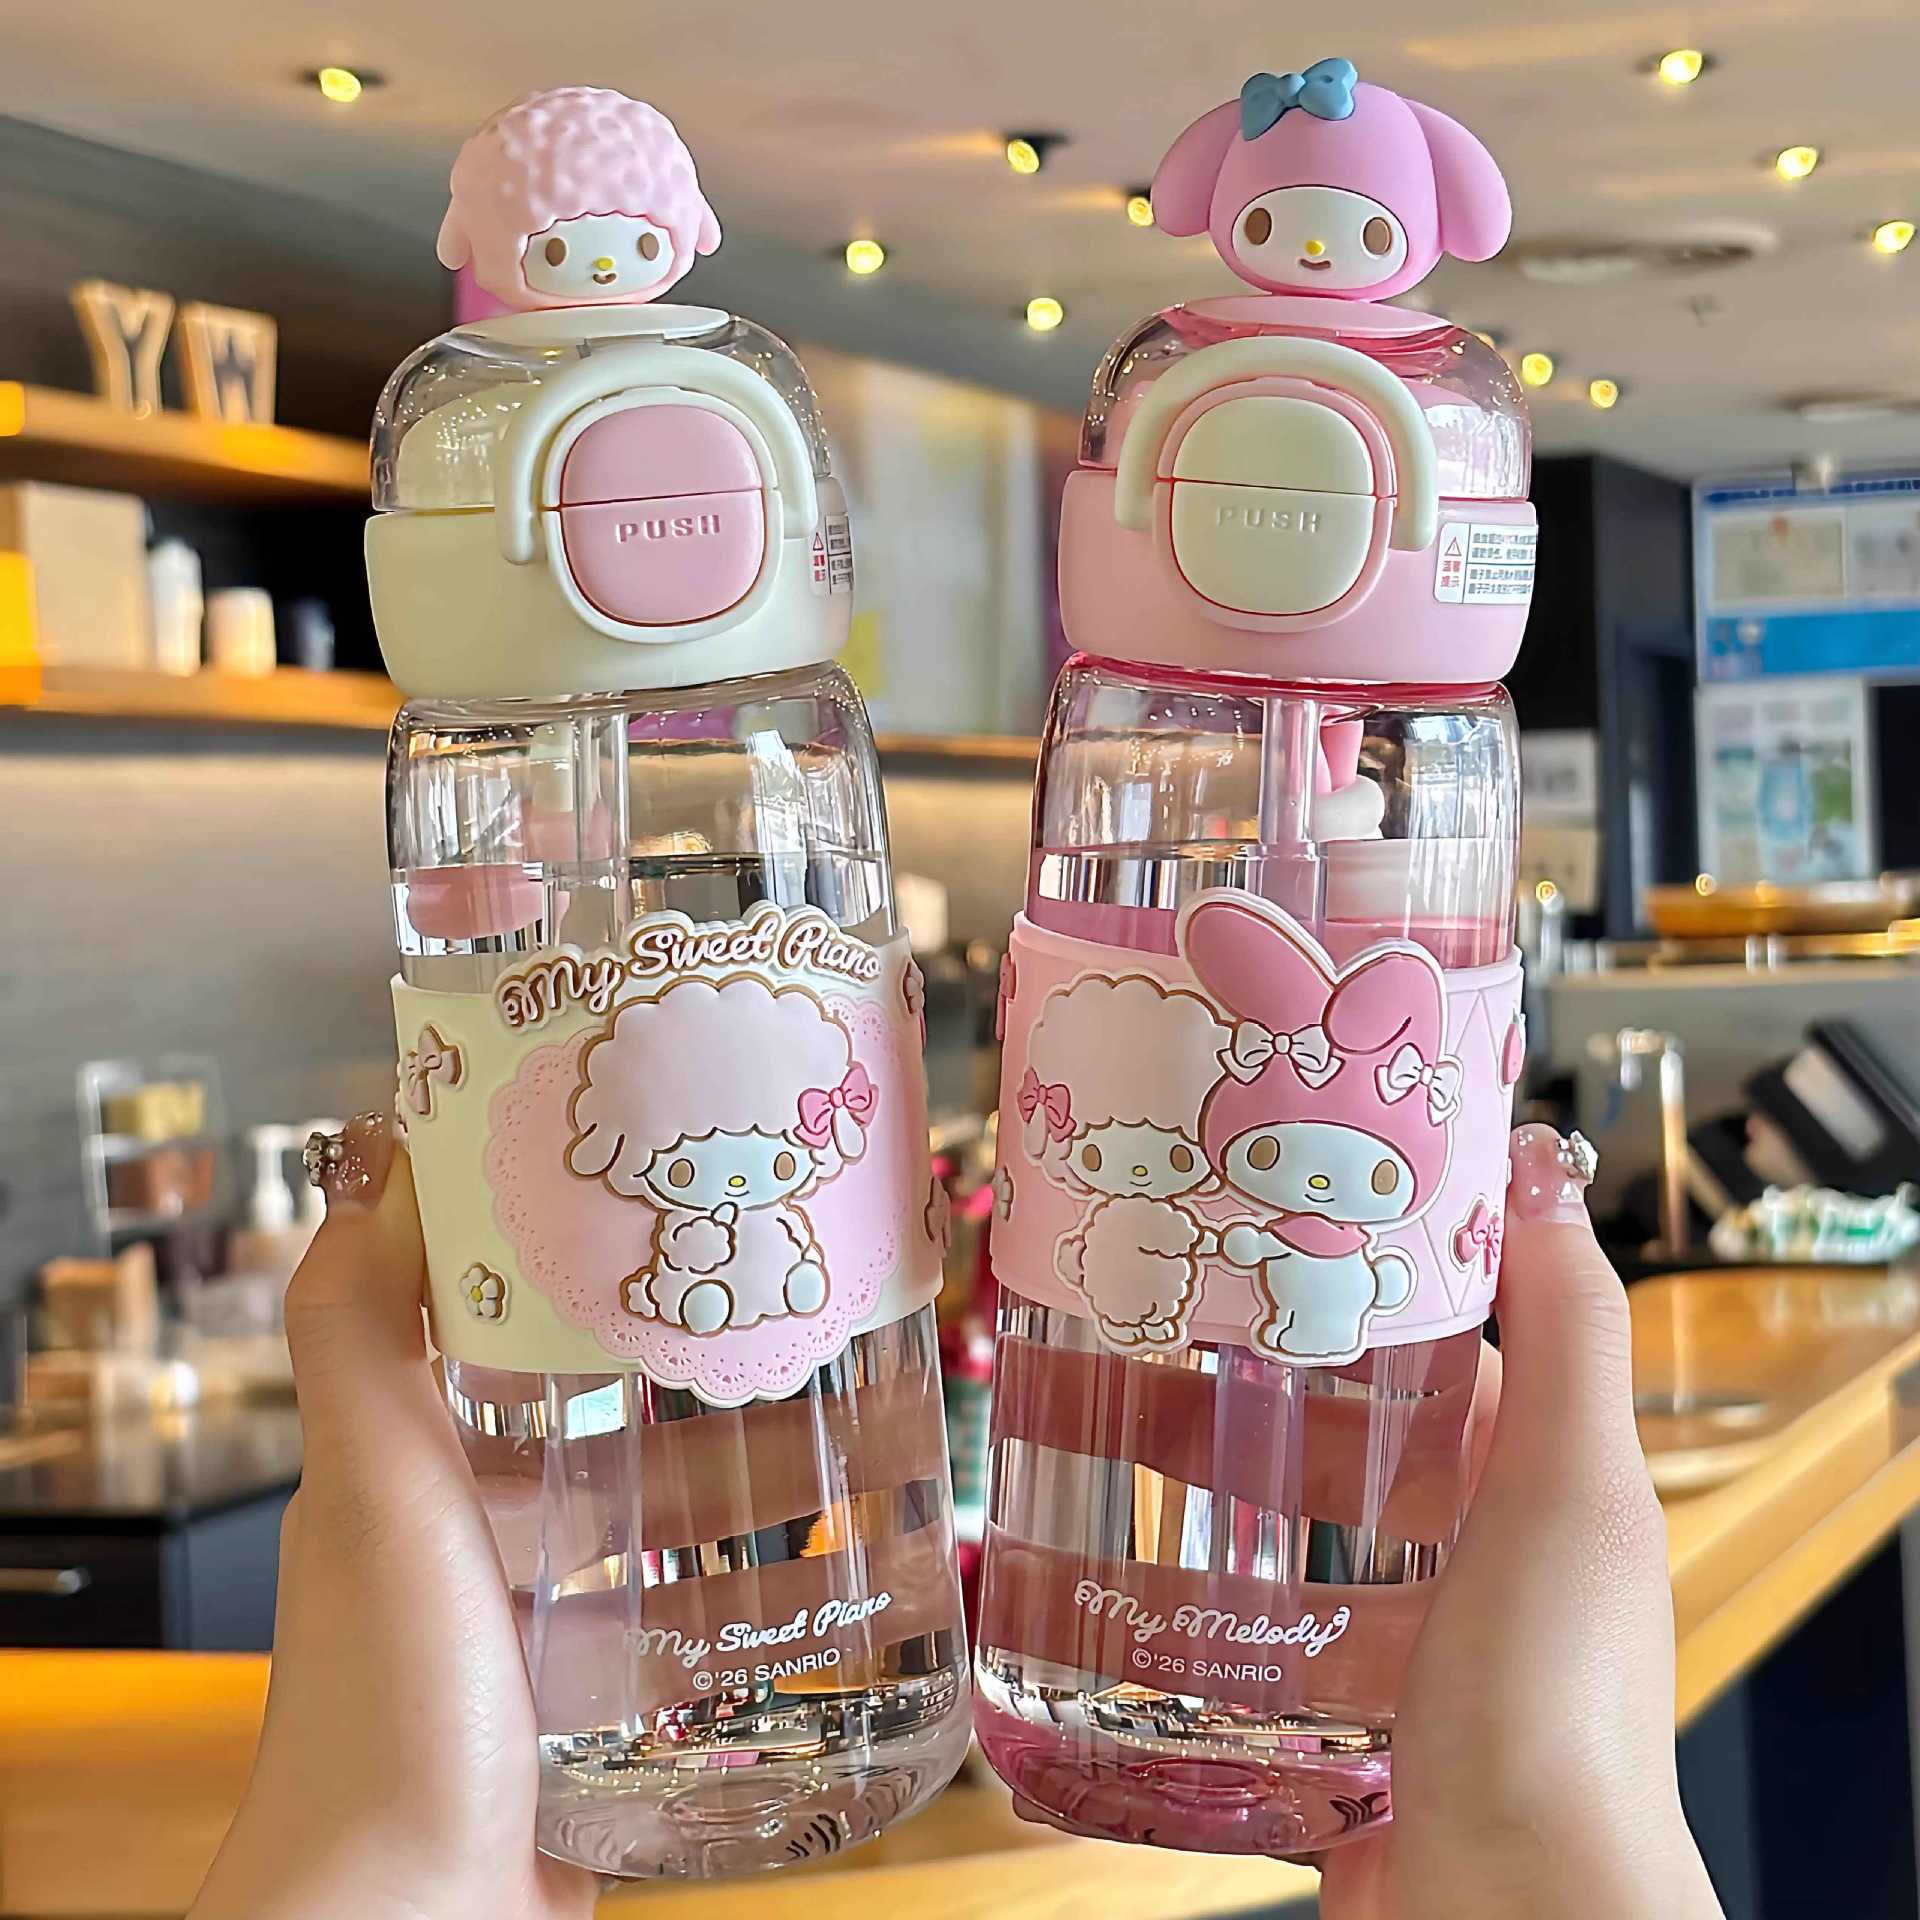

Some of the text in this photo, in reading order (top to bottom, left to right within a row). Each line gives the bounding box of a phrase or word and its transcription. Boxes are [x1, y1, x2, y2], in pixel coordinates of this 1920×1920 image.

[615, 514, 721, 544] PUSH
[1215, 504, 1322, 534] PUSH
[502, 915, 882, 1027] My Sweet Piano
[624, 1592, 892, 1669] My Sweet Piano
[1074, 1578, 1350, 1658] My Melody
[754, 1647, 841, 1682] SANRIO
[1192, 1660, 1282, 1683] SANRIO
